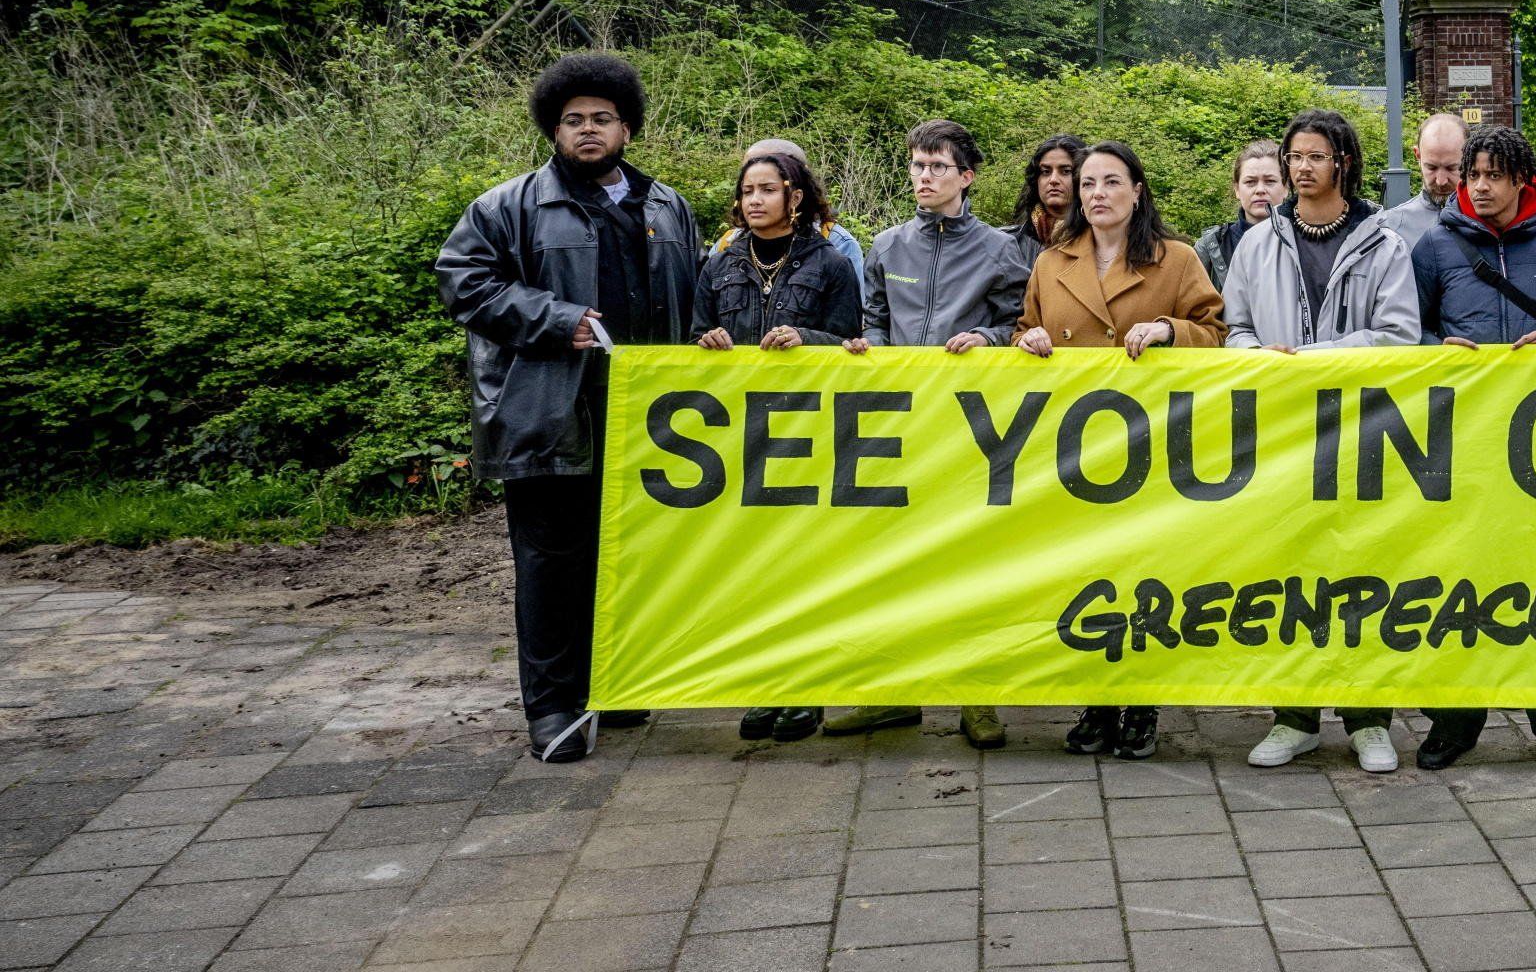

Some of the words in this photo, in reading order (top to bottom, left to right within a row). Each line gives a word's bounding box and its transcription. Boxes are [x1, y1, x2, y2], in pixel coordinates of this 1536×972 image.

[1466, 110, 1478, 121] 10
[640, 390, 913, 509] SEE
[954, 389, 1258, 506] YOU
[1312, 385, 1456, 503] IN
